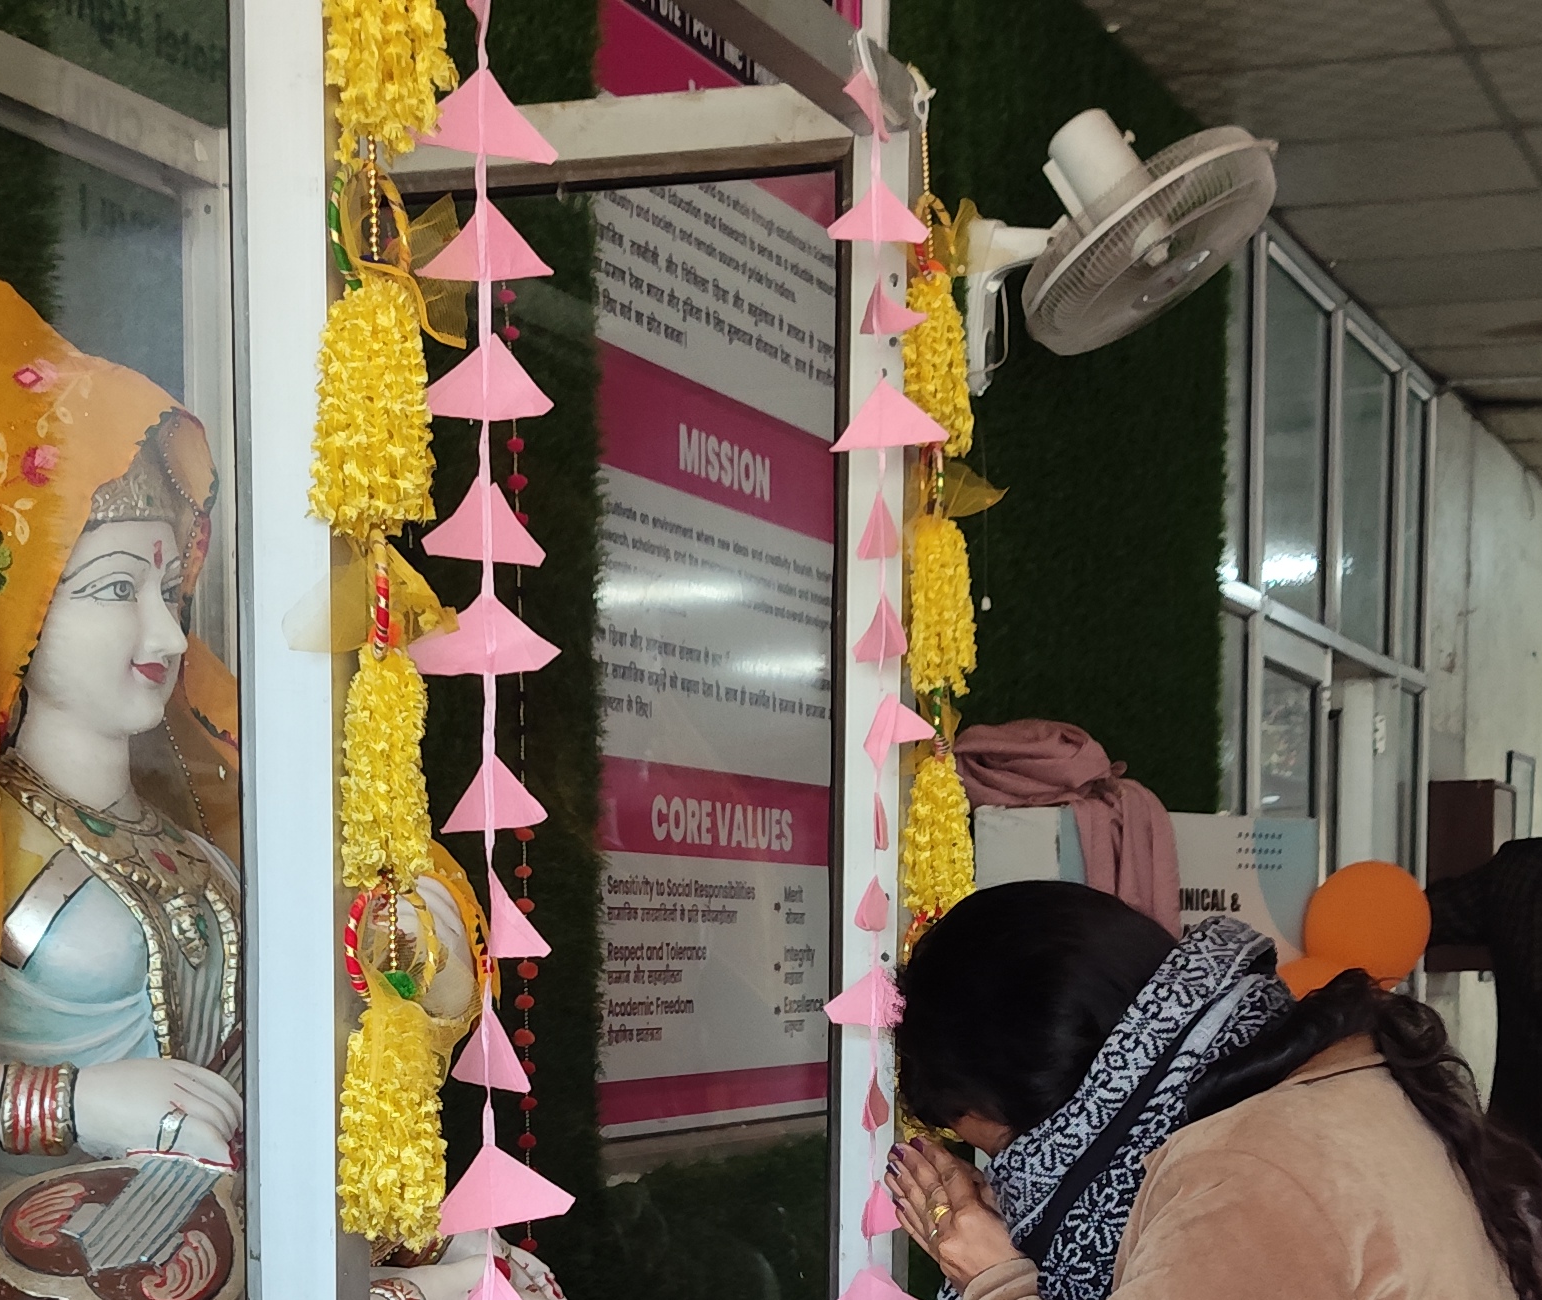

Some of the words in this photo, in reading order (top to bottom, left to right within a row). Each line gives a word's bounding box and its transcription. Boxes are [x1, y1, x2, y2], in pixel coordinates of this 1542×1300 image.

[678, 422, 772, 503] MISSION
[651, 794, 713, 846] CORE
[715, 802, 793, 852] VALUES
[607, 875, 654, 902] Sensitivity
[656, 878, 665, 897] to
[667, 879, 692, 898] Social
[694, 880, 755, 908] Responsibilities
[1231, 892, 1241, 912] &
[607, 943, 644, 967] Respect
[644, 943, 664, 961] and
[666, 943, 707, 961] Tolerance
[784, 944, 815, 966] Integrity
[607, 996, 654, 1017] Academic
[656, 996, 694, 1016] Freedom
[784, 995, 824, 1015] Excellence
